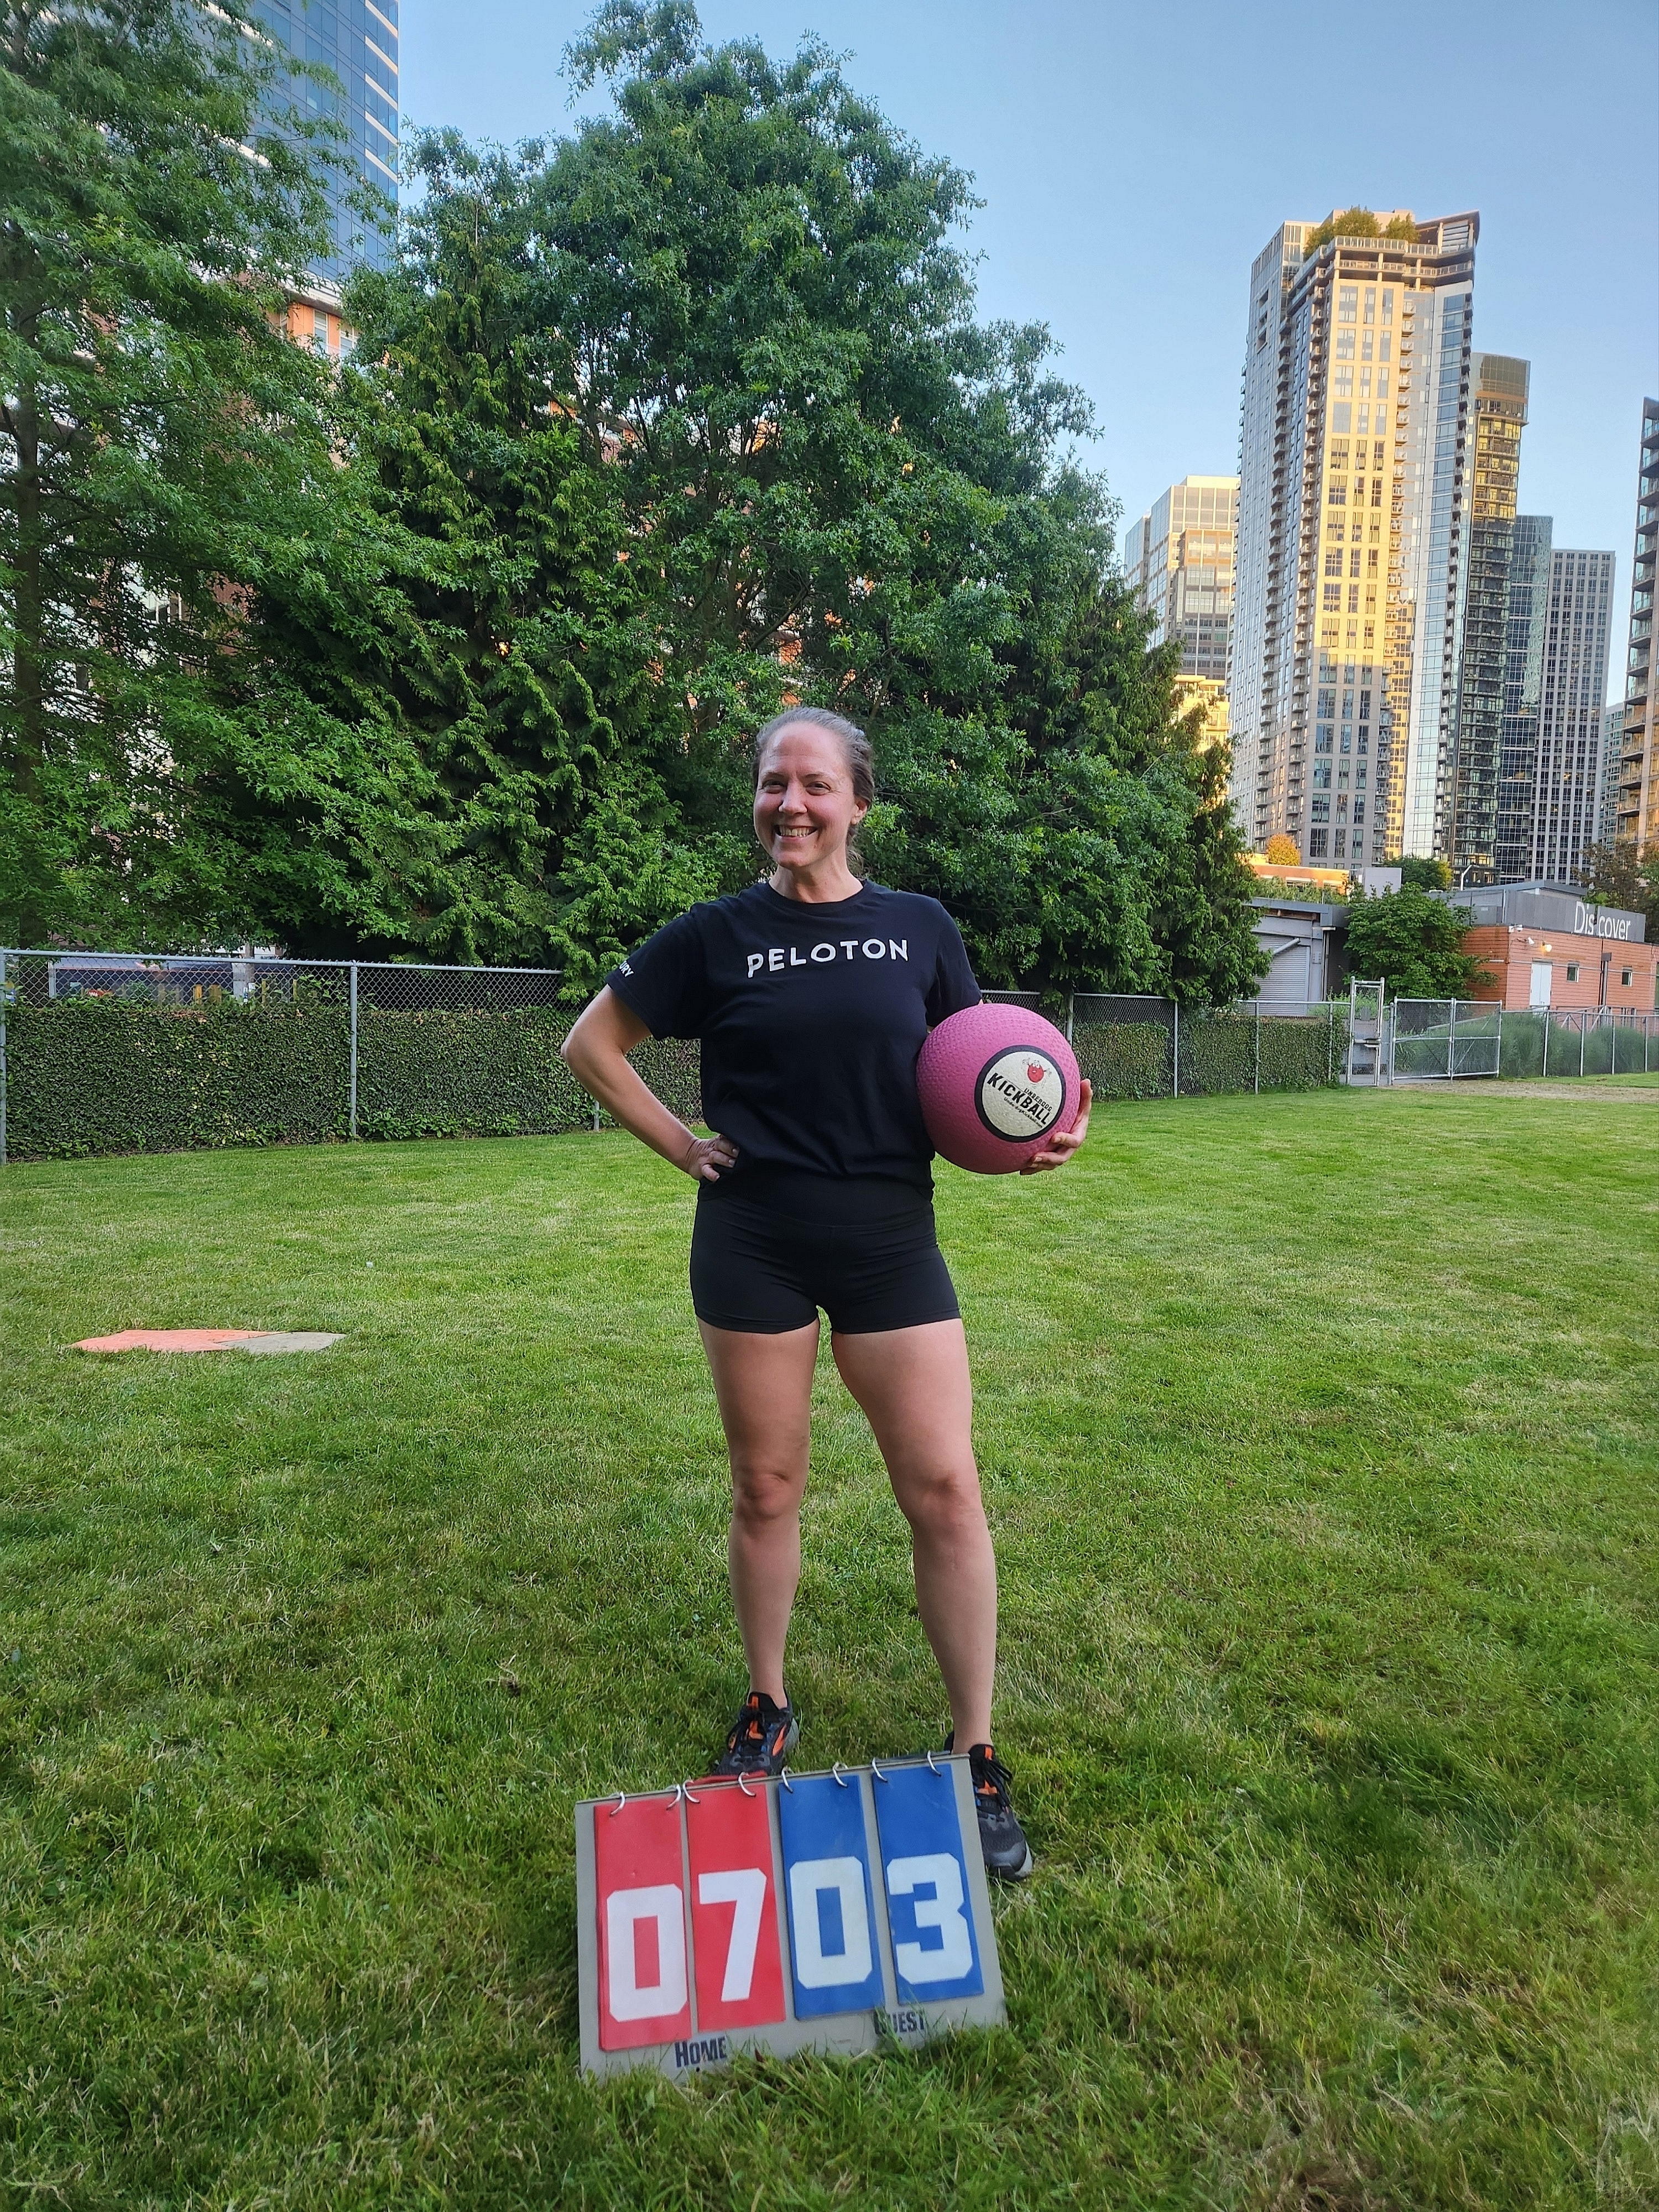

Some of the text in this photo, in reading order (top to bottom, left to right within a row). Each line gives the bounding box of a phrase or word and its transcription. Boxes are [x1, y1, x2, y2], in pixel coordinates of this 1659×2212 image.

[747, 938, 908, 978] PELOTON
[987, 1072, 1050, 1125] KICKBALL
[675, 2036, 728, 2068] HOME
